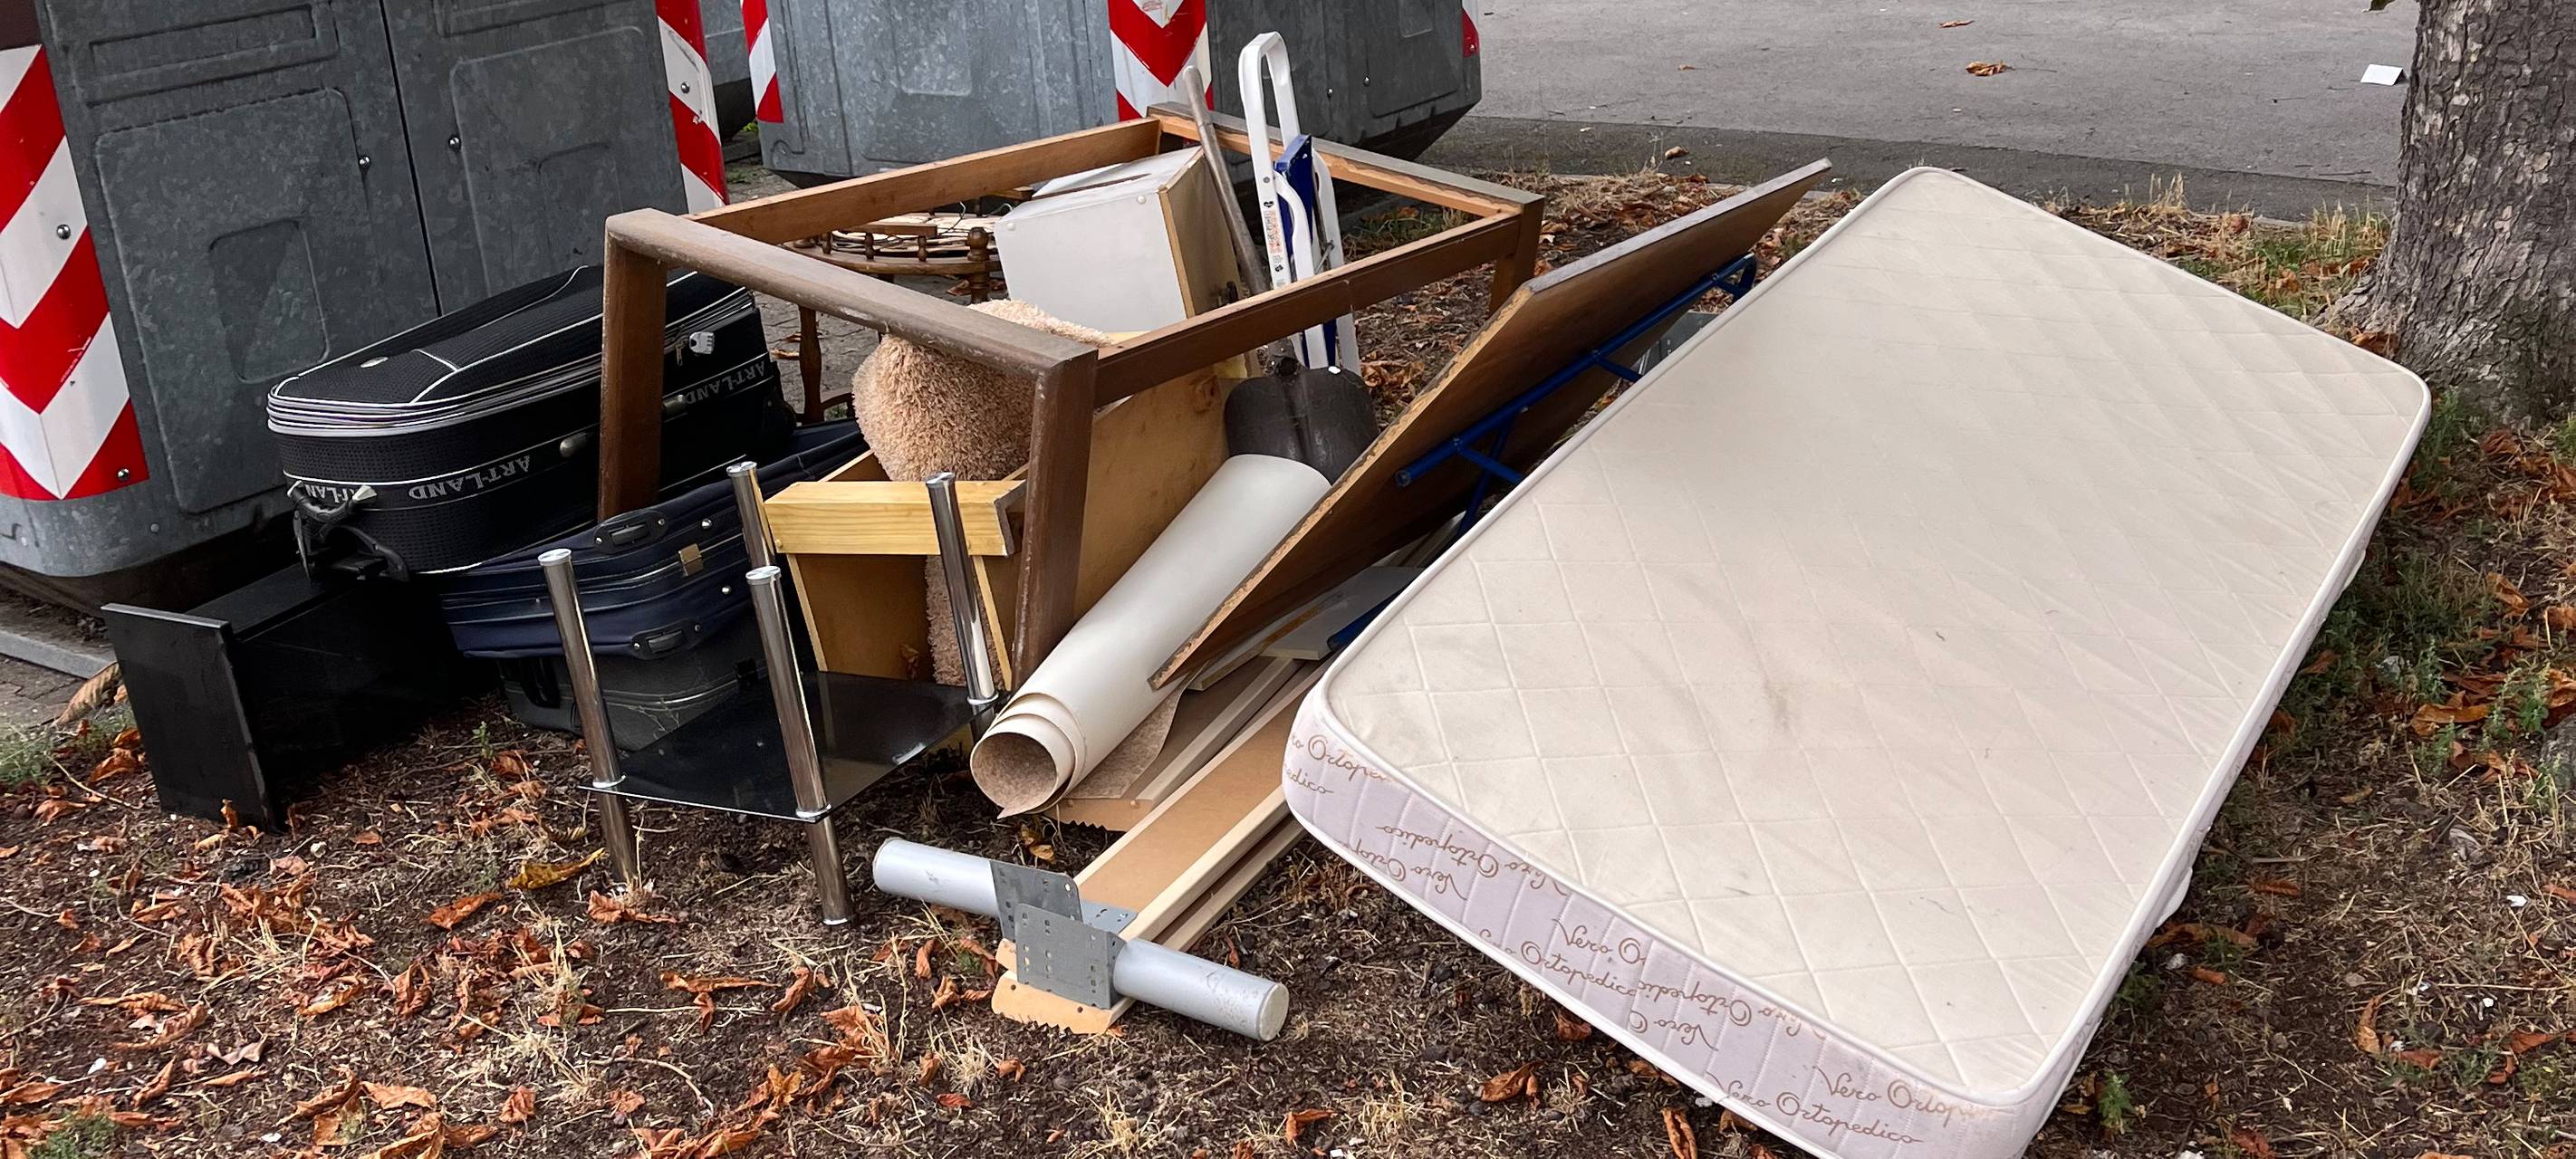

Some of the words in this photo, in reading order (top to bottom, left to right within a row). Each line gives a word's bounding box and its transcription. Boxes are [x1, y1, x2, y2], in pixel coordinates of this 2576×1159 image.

[684, 360, 765, 405] ART-LAND
[408, 455, 531, 500] ART-LAND
[1375, 825, 1499, 878] Ortopedico
[1410, 867, 1468, 901] Vero
[1552, 918, 1612, 954] Vero
[1653, 1019, 1718, 1051] Vero
[1812, 1065, 1881, 1099] Vero
[1776, 1092, 1924, 1144] Ortopedico
